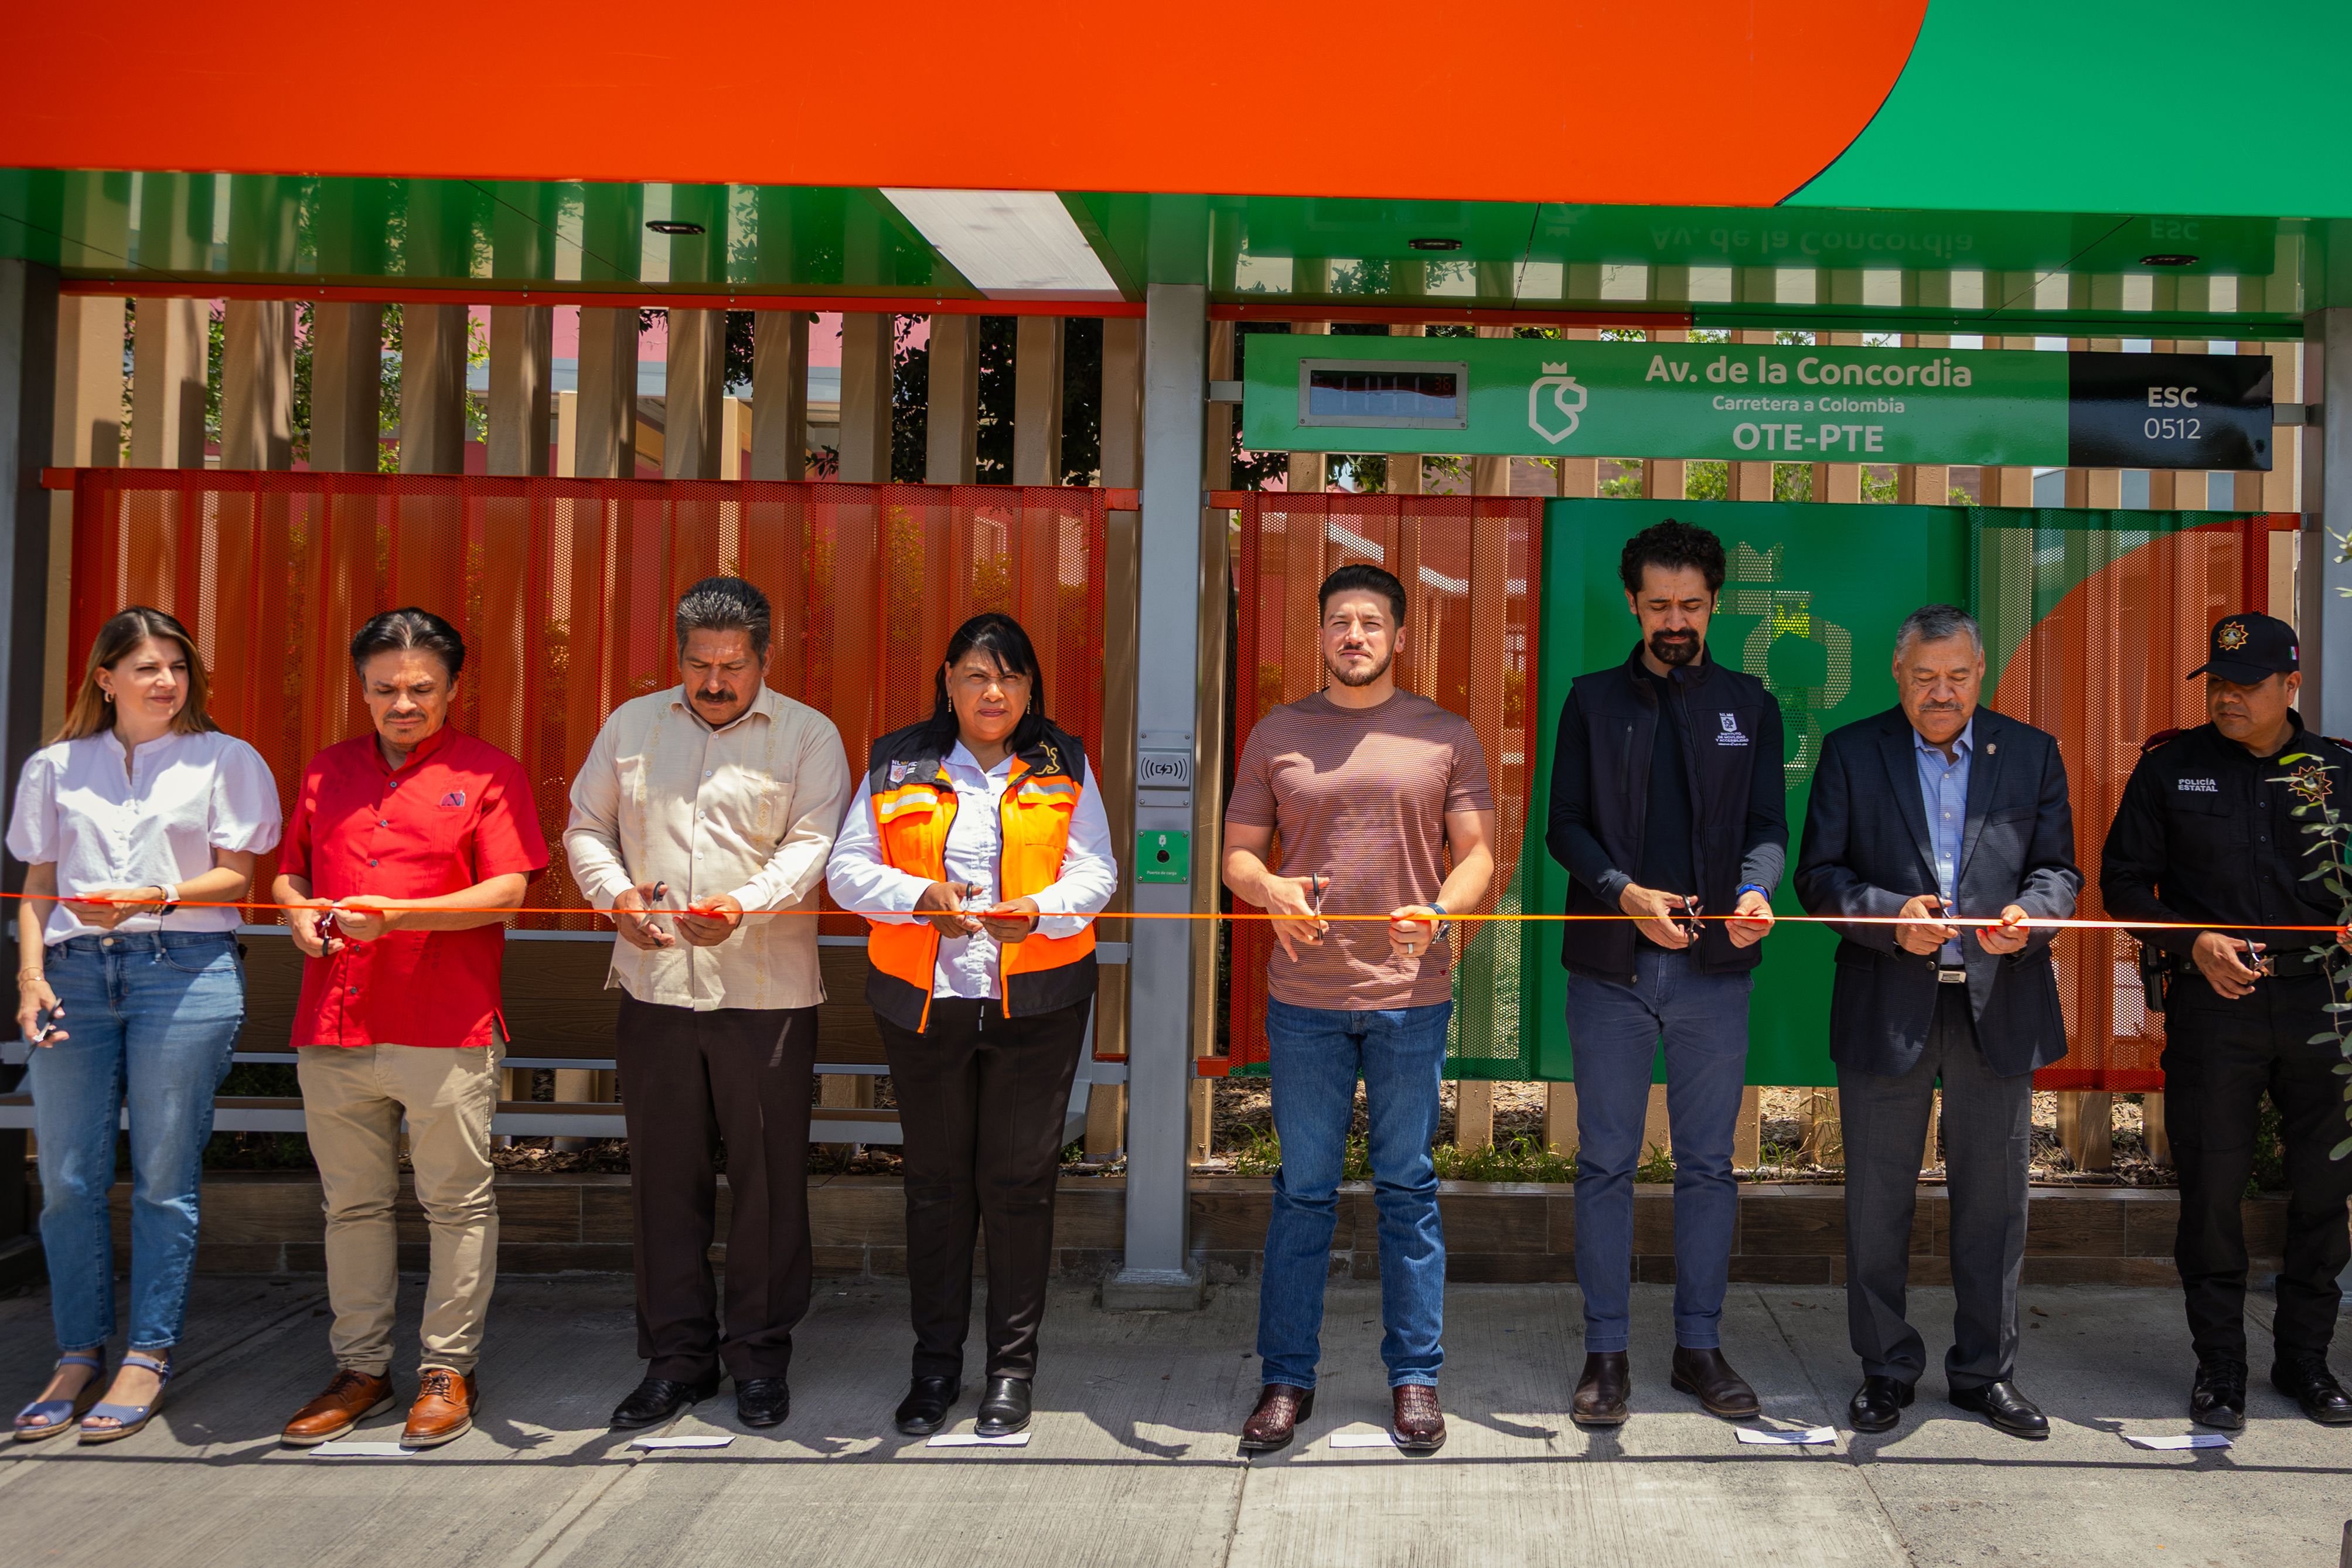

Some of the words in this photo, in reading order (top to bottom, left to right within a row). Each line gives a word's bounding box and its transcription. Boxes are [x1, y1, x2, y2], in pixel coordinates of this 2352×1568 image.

[1645, 354, 1698, 383] Av.
[1706, 356, 1748, 384] de
[1758, 356, 1787, 384] la
[1797, 357, 1972, 387] Concordia
[1712, 396, 1798, 411] Carretera
[1804, 400, 1815, 412] a
[1818, 397, 1905, 413] Colombia
[2148, 387, 2198, 408] ESC
[1732, 422, 1884, 452] OTE-PTE
[2144, 418, 2201, 439] 0512
